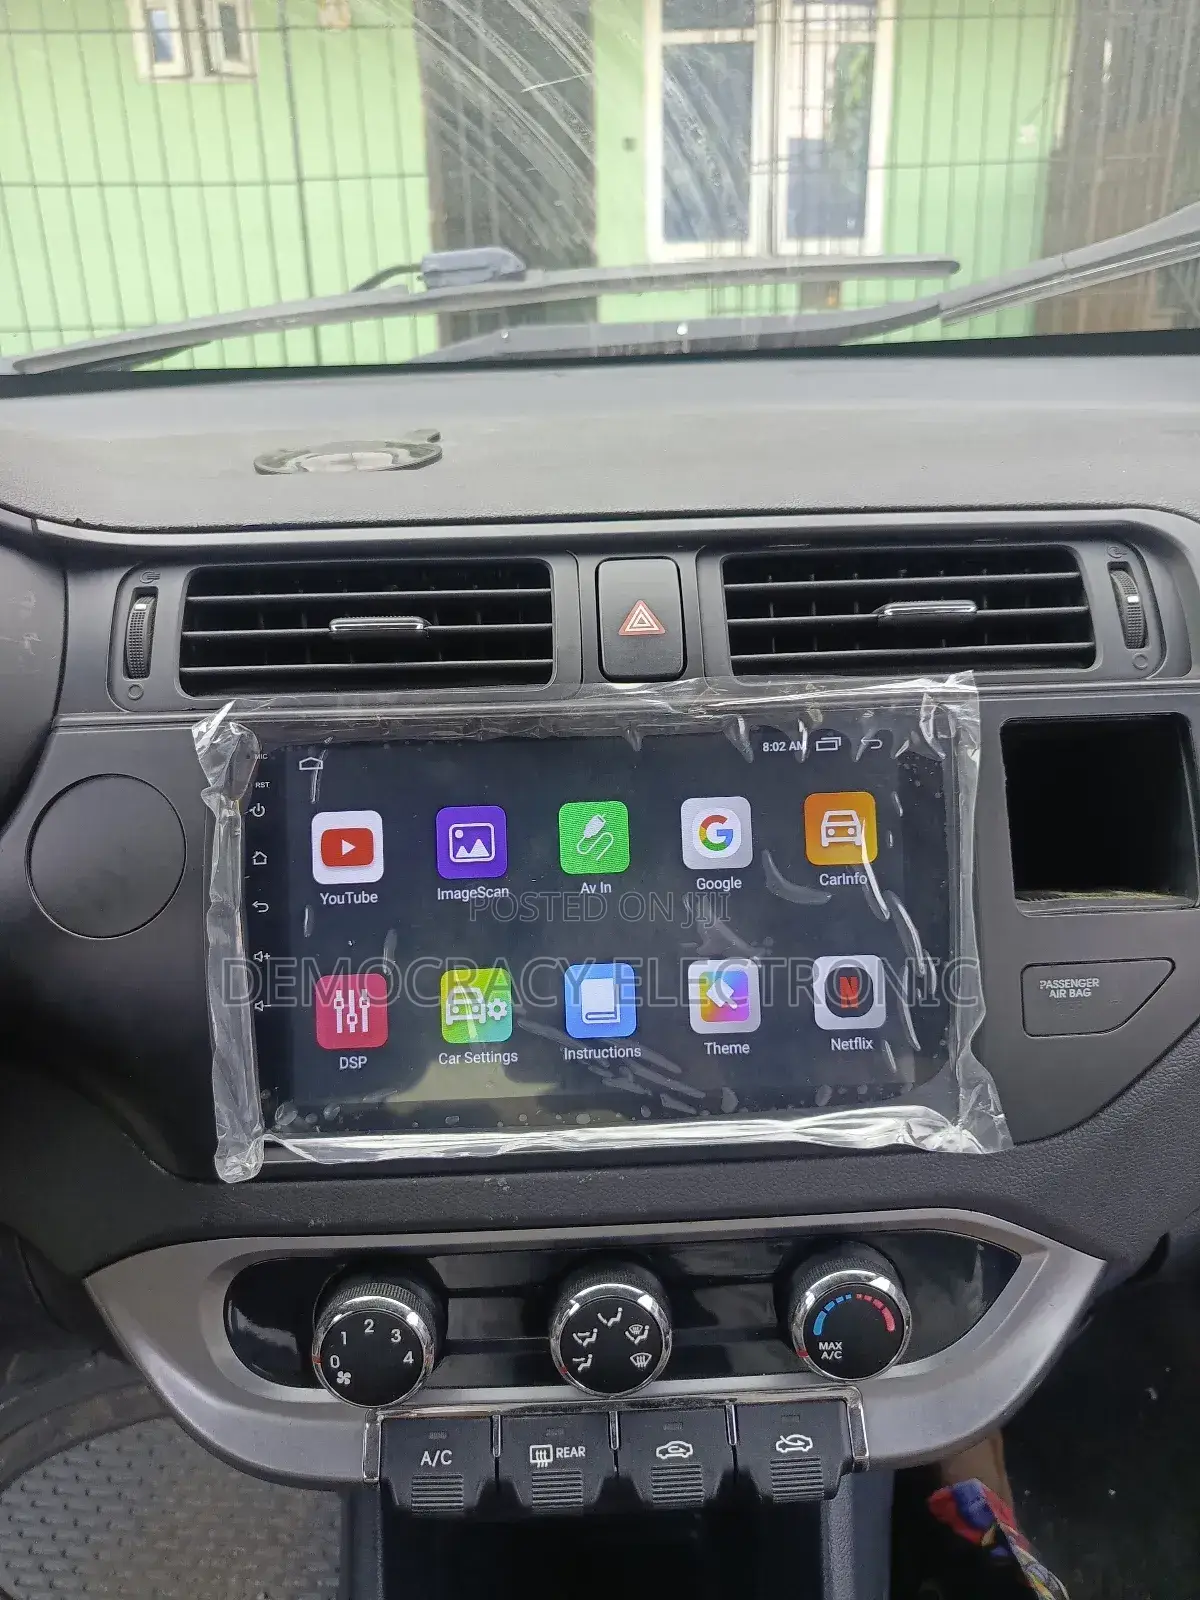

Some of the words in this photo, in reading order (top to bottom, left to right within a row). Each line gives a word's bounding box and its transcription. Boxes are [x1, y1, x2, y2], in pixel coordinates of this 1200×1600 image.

[762, 741, 787, 752] 8:02
[699, 814, 734, 851] G
[696, 876, 742, 892] Google
[819, 872, 868, 886] CarInfo
[436, 884, 510, 903] ImageScan
[580, 882, 598, 895] Av
[600, 881, 612, 894] In
[319, 890, 379, 906] YouTube
[1039, 978, 1100, 990] PASSENGER
[1049, 989, 1067, 998] AIR
[1069, 988, 1092, 998] BAG
[704, 1041, 750, 1056] Theme
[830, 1036, 874, 1052] Netflix
[438, 1052, 461, 1065] Car
[464, 1050, 519, 1067] Settings
[563, 1044, 642, 1060] Instructions
[339, 1056, 368, 1069] DSP
[363, 1318, 375, 1333] 2
[340, 1331, 347, 1345] 1
[390, 1328, 402, 1343] 3
[818, 1341, 843, 1350] MAX
[329, 1354, 340, 1369] 0
[402, 1350, 414, 1364] 4
[820, 1350, 843, 1360] A/C
[420, 1449, 453, 1467] A/C
[555, 1445, 586, 1459] REAR
